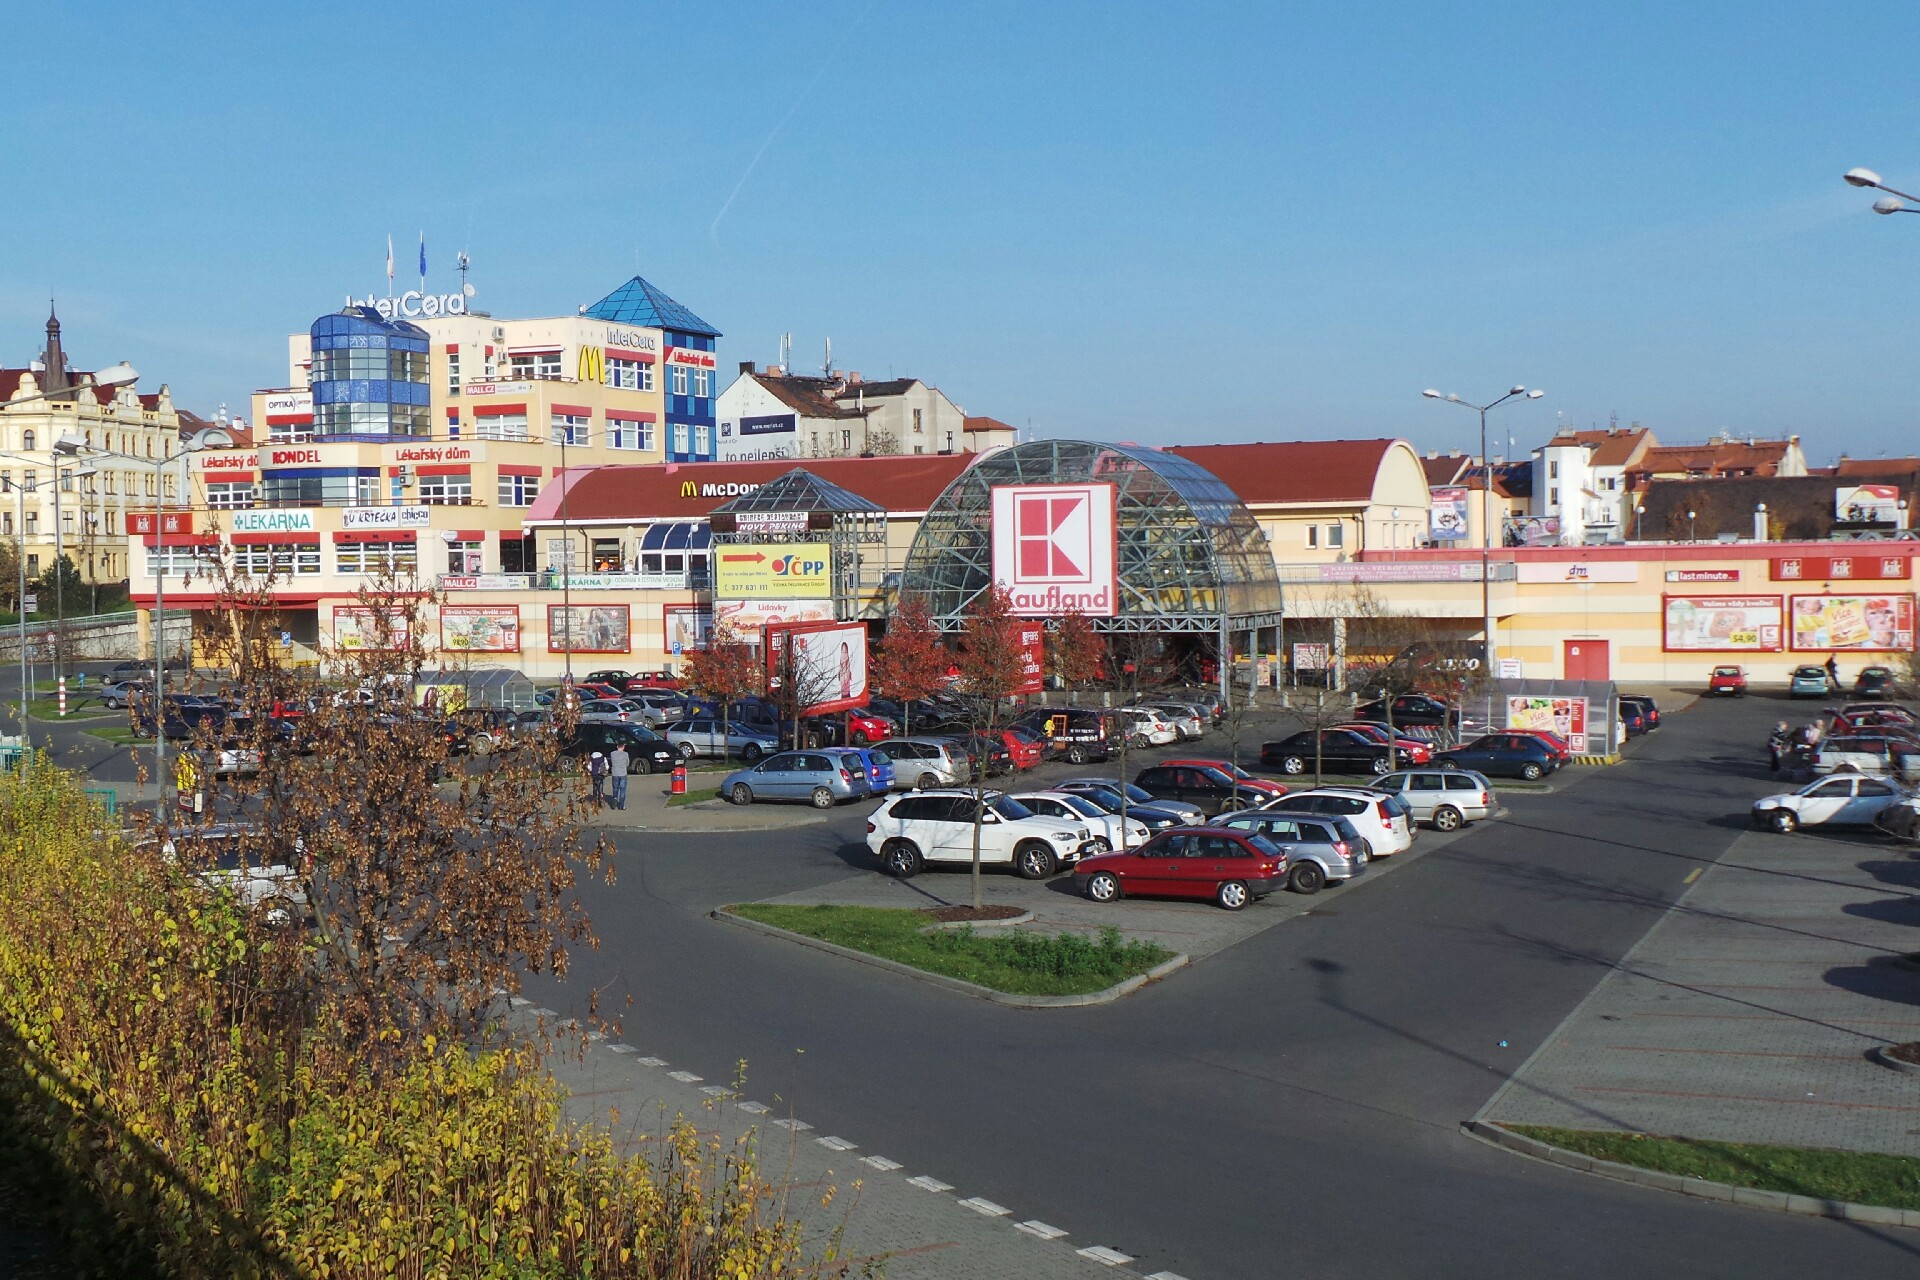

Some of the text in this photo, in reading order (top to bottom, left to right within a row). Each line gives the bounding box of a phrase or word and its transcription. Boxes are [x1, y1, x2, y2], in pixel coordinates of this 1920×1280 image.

[607, 327, 655, 350] InterCora
[268, 400, 294, 408] OPTIKA
[272, 450, 321, 464] RONDEL
[396, 447, 470, 462] Lékařský dům
[726, 452, 736, 461] to
[202, 454, 258, 469] Lékařský dů
[402, 508, 428, 520] chicco
[245, 512, 310, 529] LÉKÁRNA
[740, 522, 765, 530] NOVÝ
[791, 556, 824, 575] ČPP
[1569, 565, 1587, 575] dm
[444, 579, 475, 587] MALL.CZ
[564, 577, 601, 585] ÉKÁRNA
[758, 604, 788, 612] Lidovky
